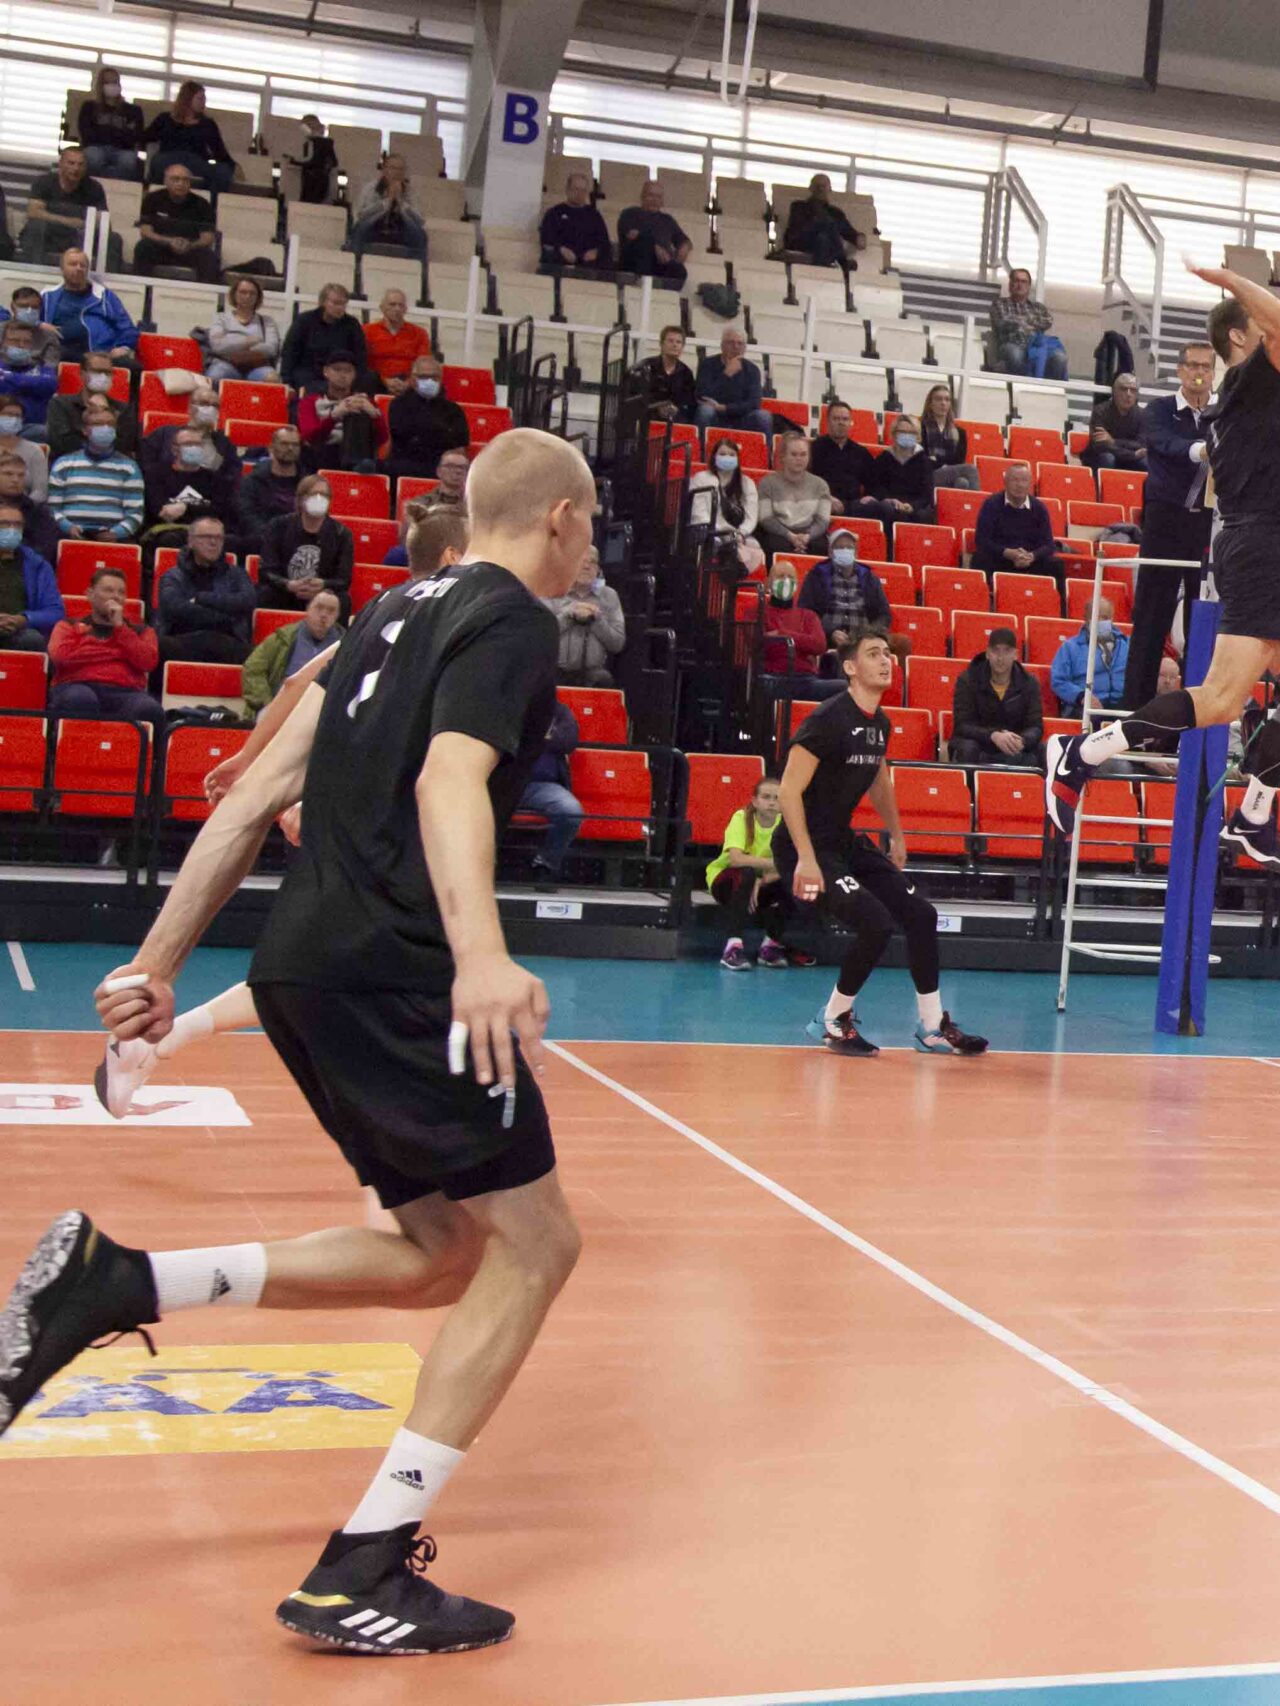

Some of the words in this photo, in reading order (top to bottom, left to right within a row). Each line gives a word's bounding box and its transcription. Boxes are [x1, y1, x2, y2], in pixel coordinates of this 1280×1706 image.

[503, 92, 539, 145] B
[835, 875, 860, 894] 13
[390, 1472, 425, 1491] adidas
